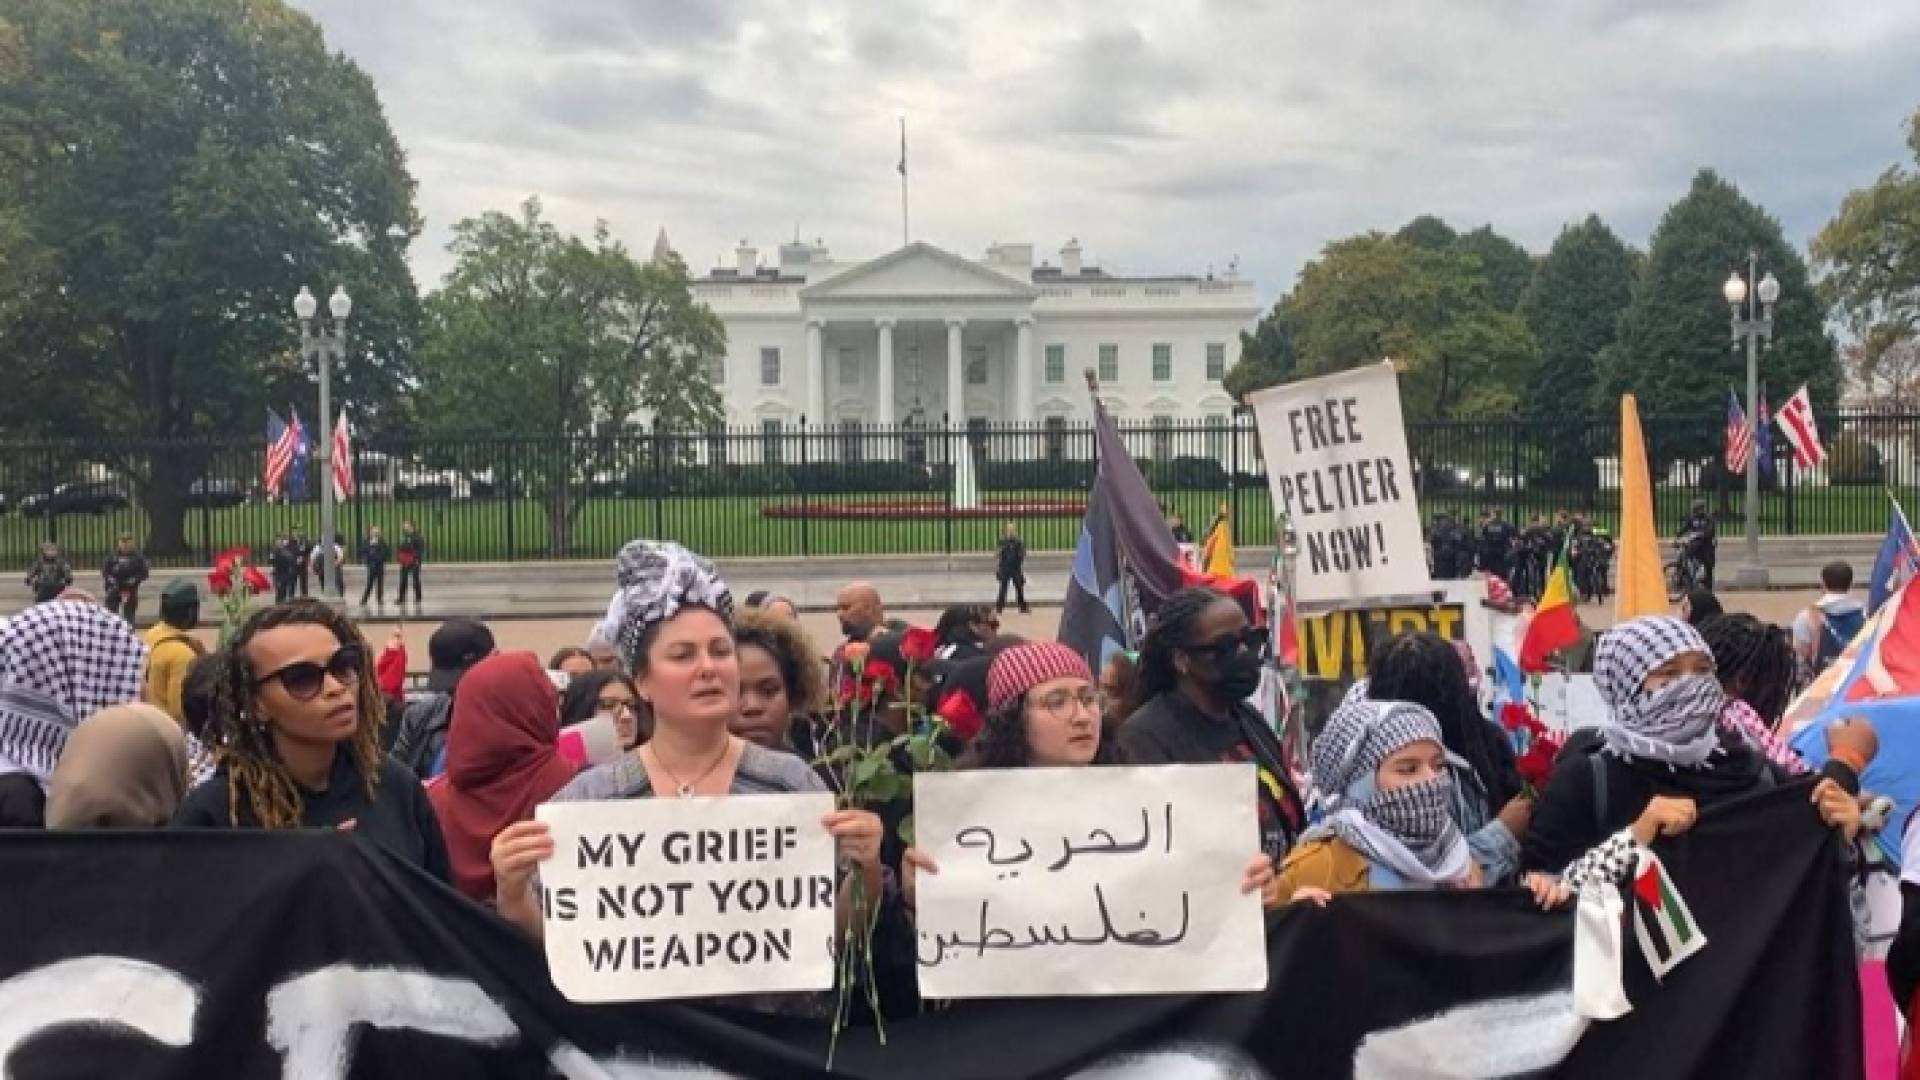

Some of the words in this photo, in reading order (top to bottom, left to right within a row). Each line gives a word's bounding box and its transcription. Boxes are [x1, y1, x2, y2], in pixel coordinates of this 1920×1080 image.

[1288, 397, 1362, 454] FREE
[1279, 456, 1401, 517] PELTIER
[1306, 521, 1389, 575] NOW!
[577, 832, 646, 869] MY
[661, 826, 797, 865] GRIEF
[545, 886, 578, 921] IS
[597, 882, 694, 920] NOT
[707, 875, 834, 914] YOUR
[583, 928, 792, 973] WEAPON
